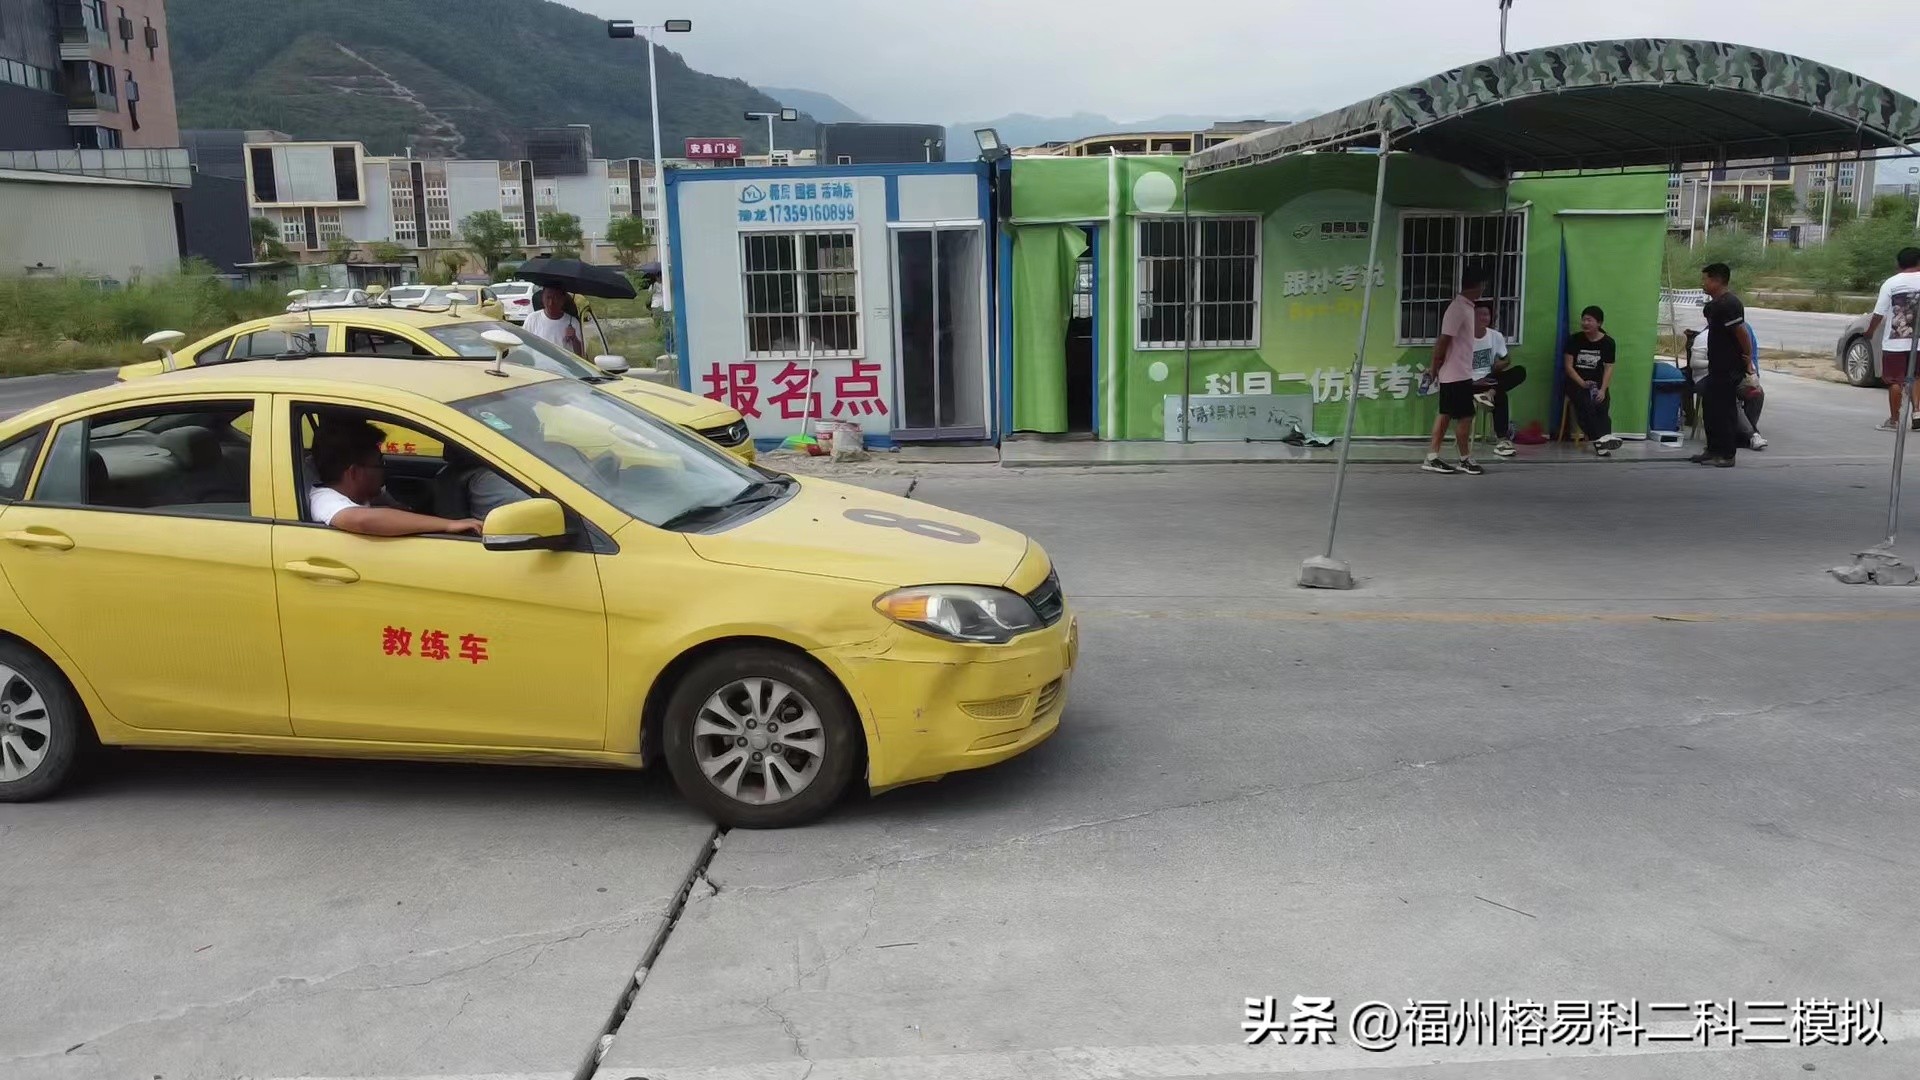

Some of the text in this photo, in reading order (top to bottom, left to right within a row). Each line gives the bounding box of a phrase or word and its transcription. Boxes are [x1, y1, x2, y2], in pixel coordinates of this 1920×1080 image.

[690, 143, 738, 154] 安鑫门业
[821, 182, 854, 199] 活动房
[769, 204, 855, 223] 17359160899
[702, 359, 889, 420] 报名点
[376, 441, 418, 454] 练车
[842, 507, 981, 545] 8
[382, 625, 489, 665] 教练车
